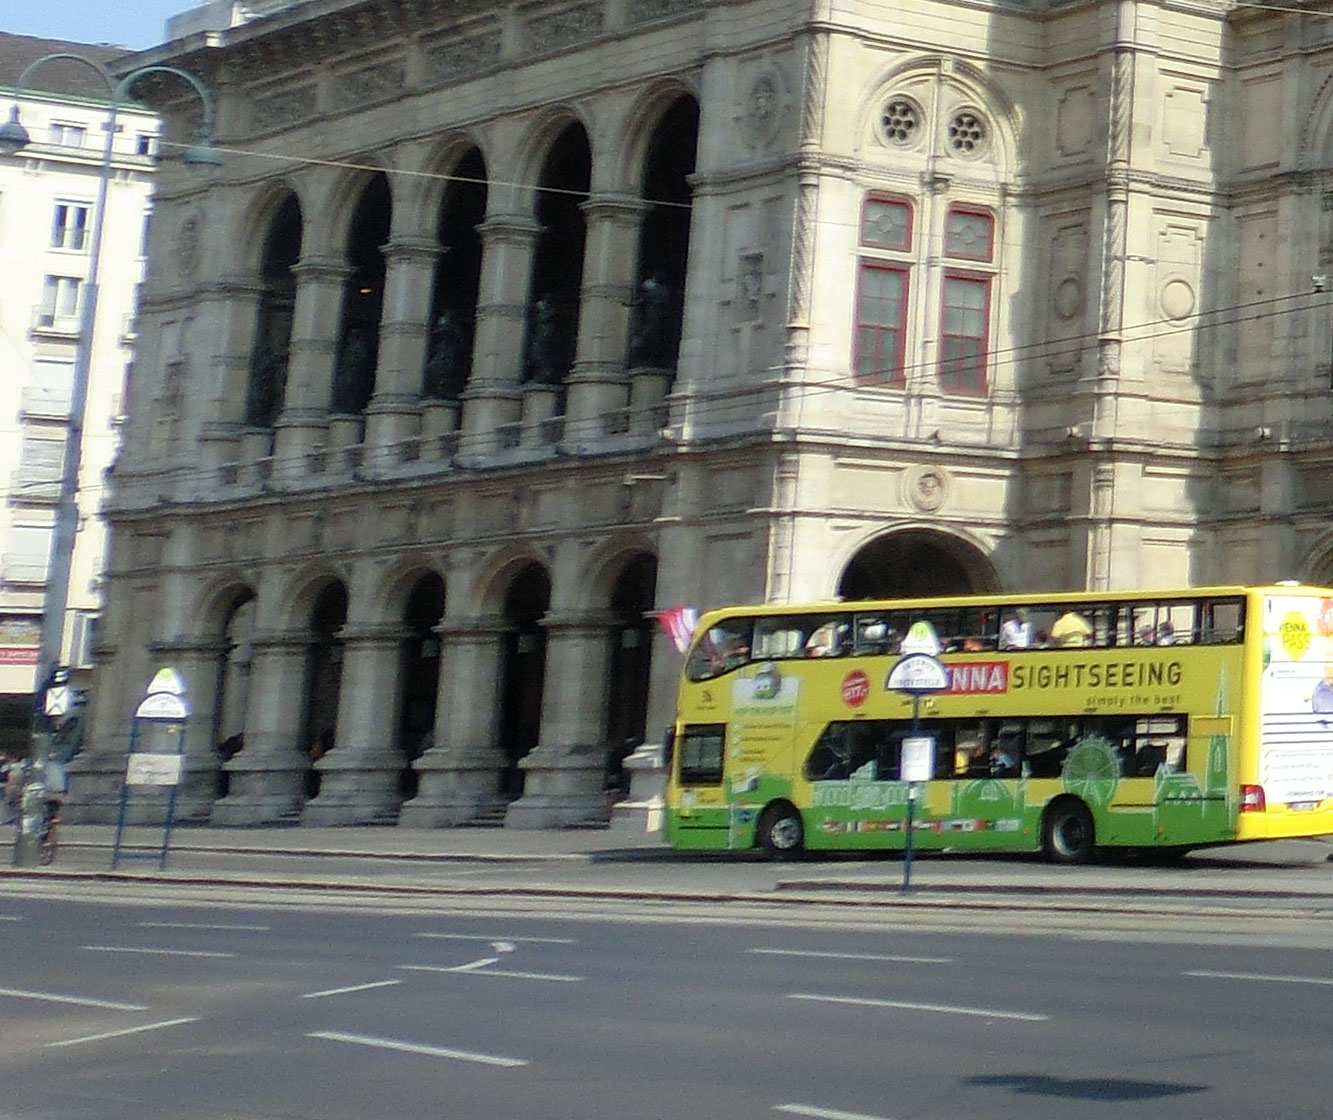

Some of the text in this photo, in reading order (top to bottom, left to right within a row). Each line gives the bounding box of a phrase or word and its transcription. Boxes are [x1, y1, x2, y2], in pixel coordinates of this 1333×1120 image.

[1011, 662, 1182, 689] SIGHTSEEING
[1129, 694, 1149, 705] the
[1154, 693, 1181, 705] best
